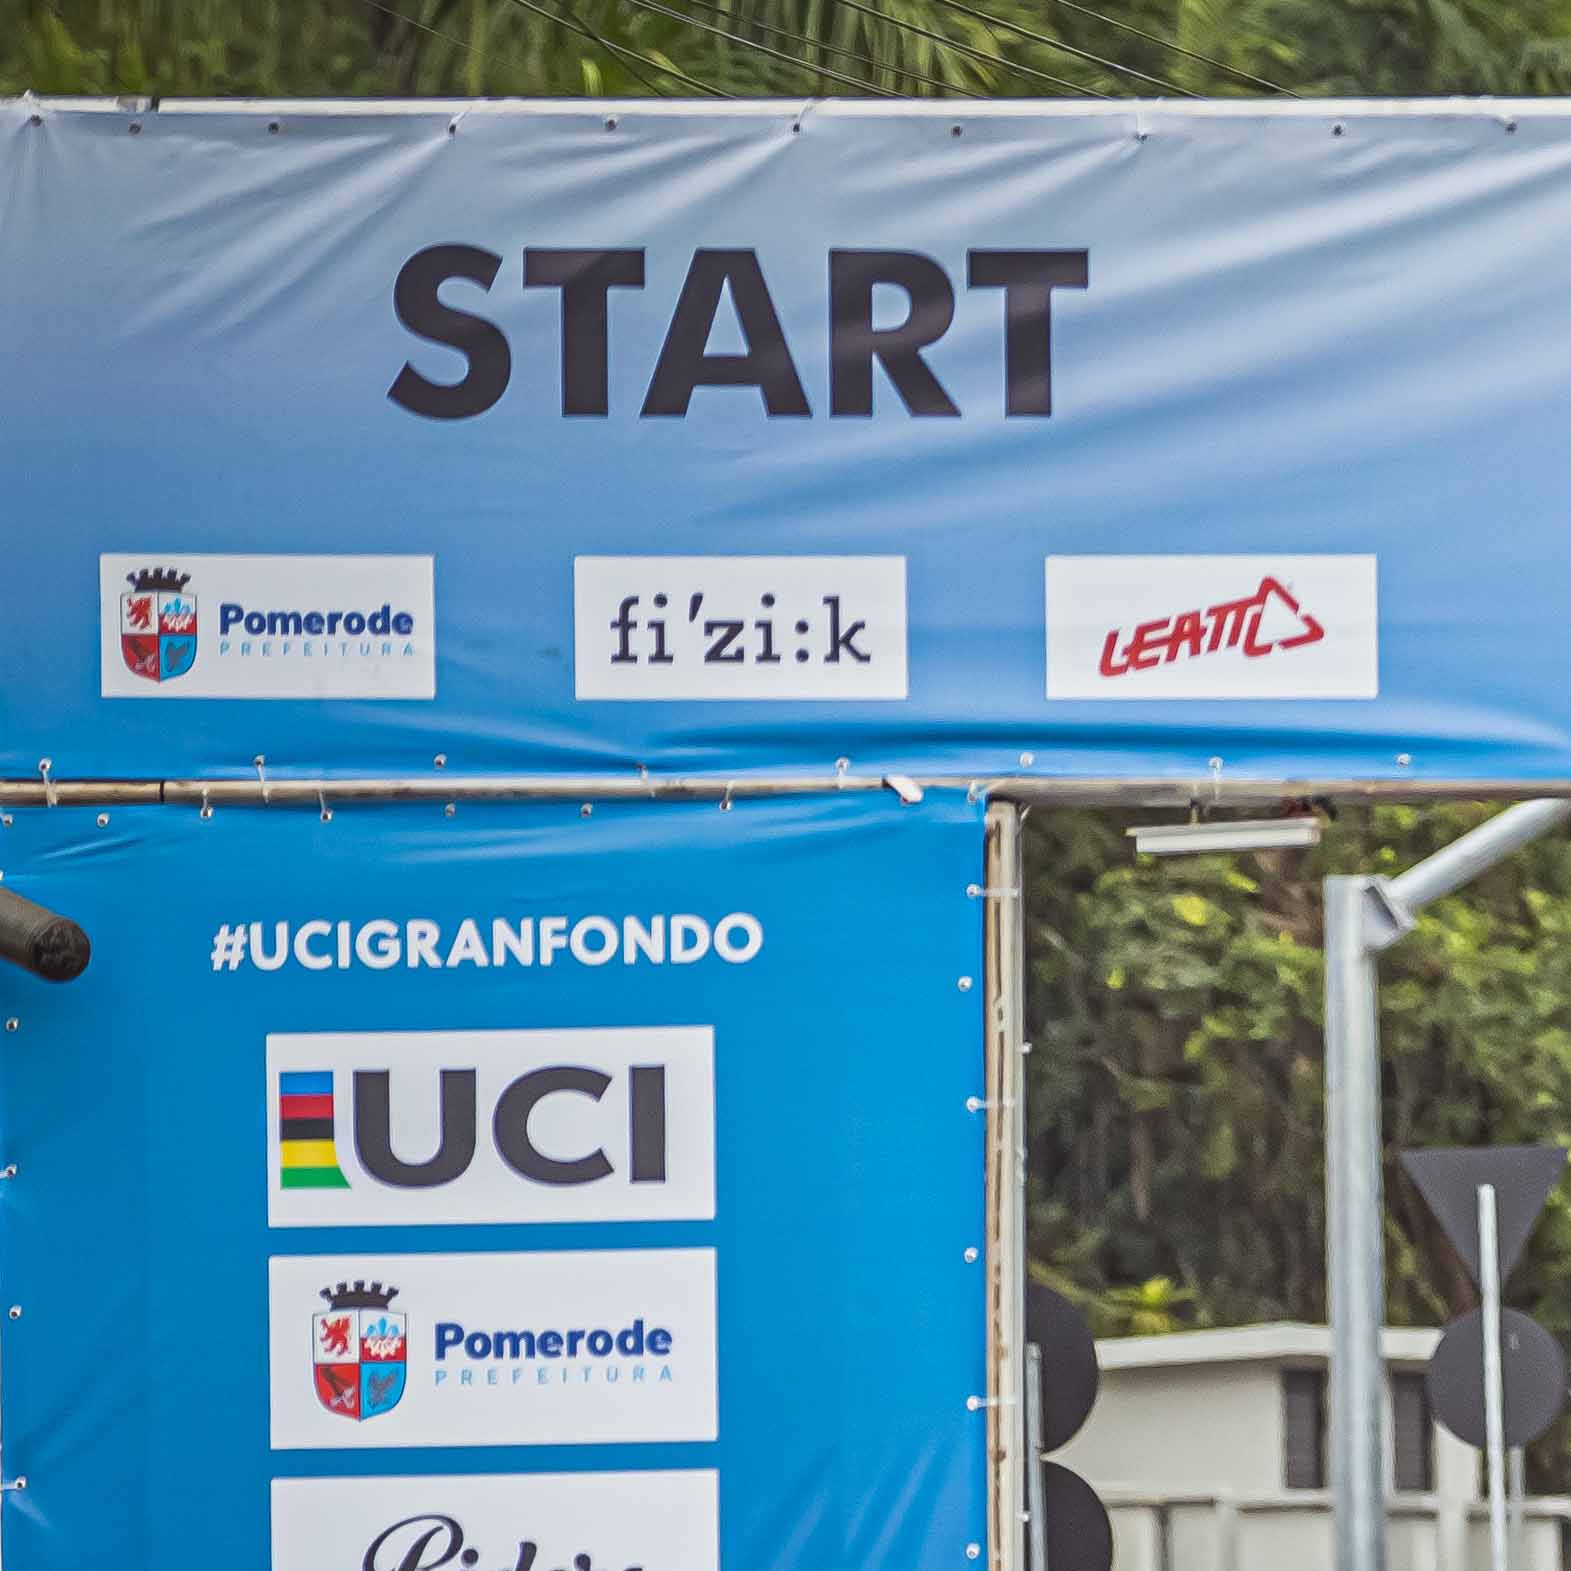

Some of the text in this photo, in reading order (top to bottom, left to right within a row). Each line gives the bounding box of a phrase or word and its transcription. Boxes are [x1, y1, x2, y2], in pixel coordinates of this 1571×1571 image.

[386, 242, 1089, 422] START
[219, 602, 414, 636] Pomerode
[218, 641, 415, 658] PREFEITURA
[210, 911, 764, 971] #UCIGRANFONDO
[352, 1063, 667, 1190] UCI
[434, 1319, 673, 1361] Pomerode
[434, 1367, 674, 1387] PREFEITURA
